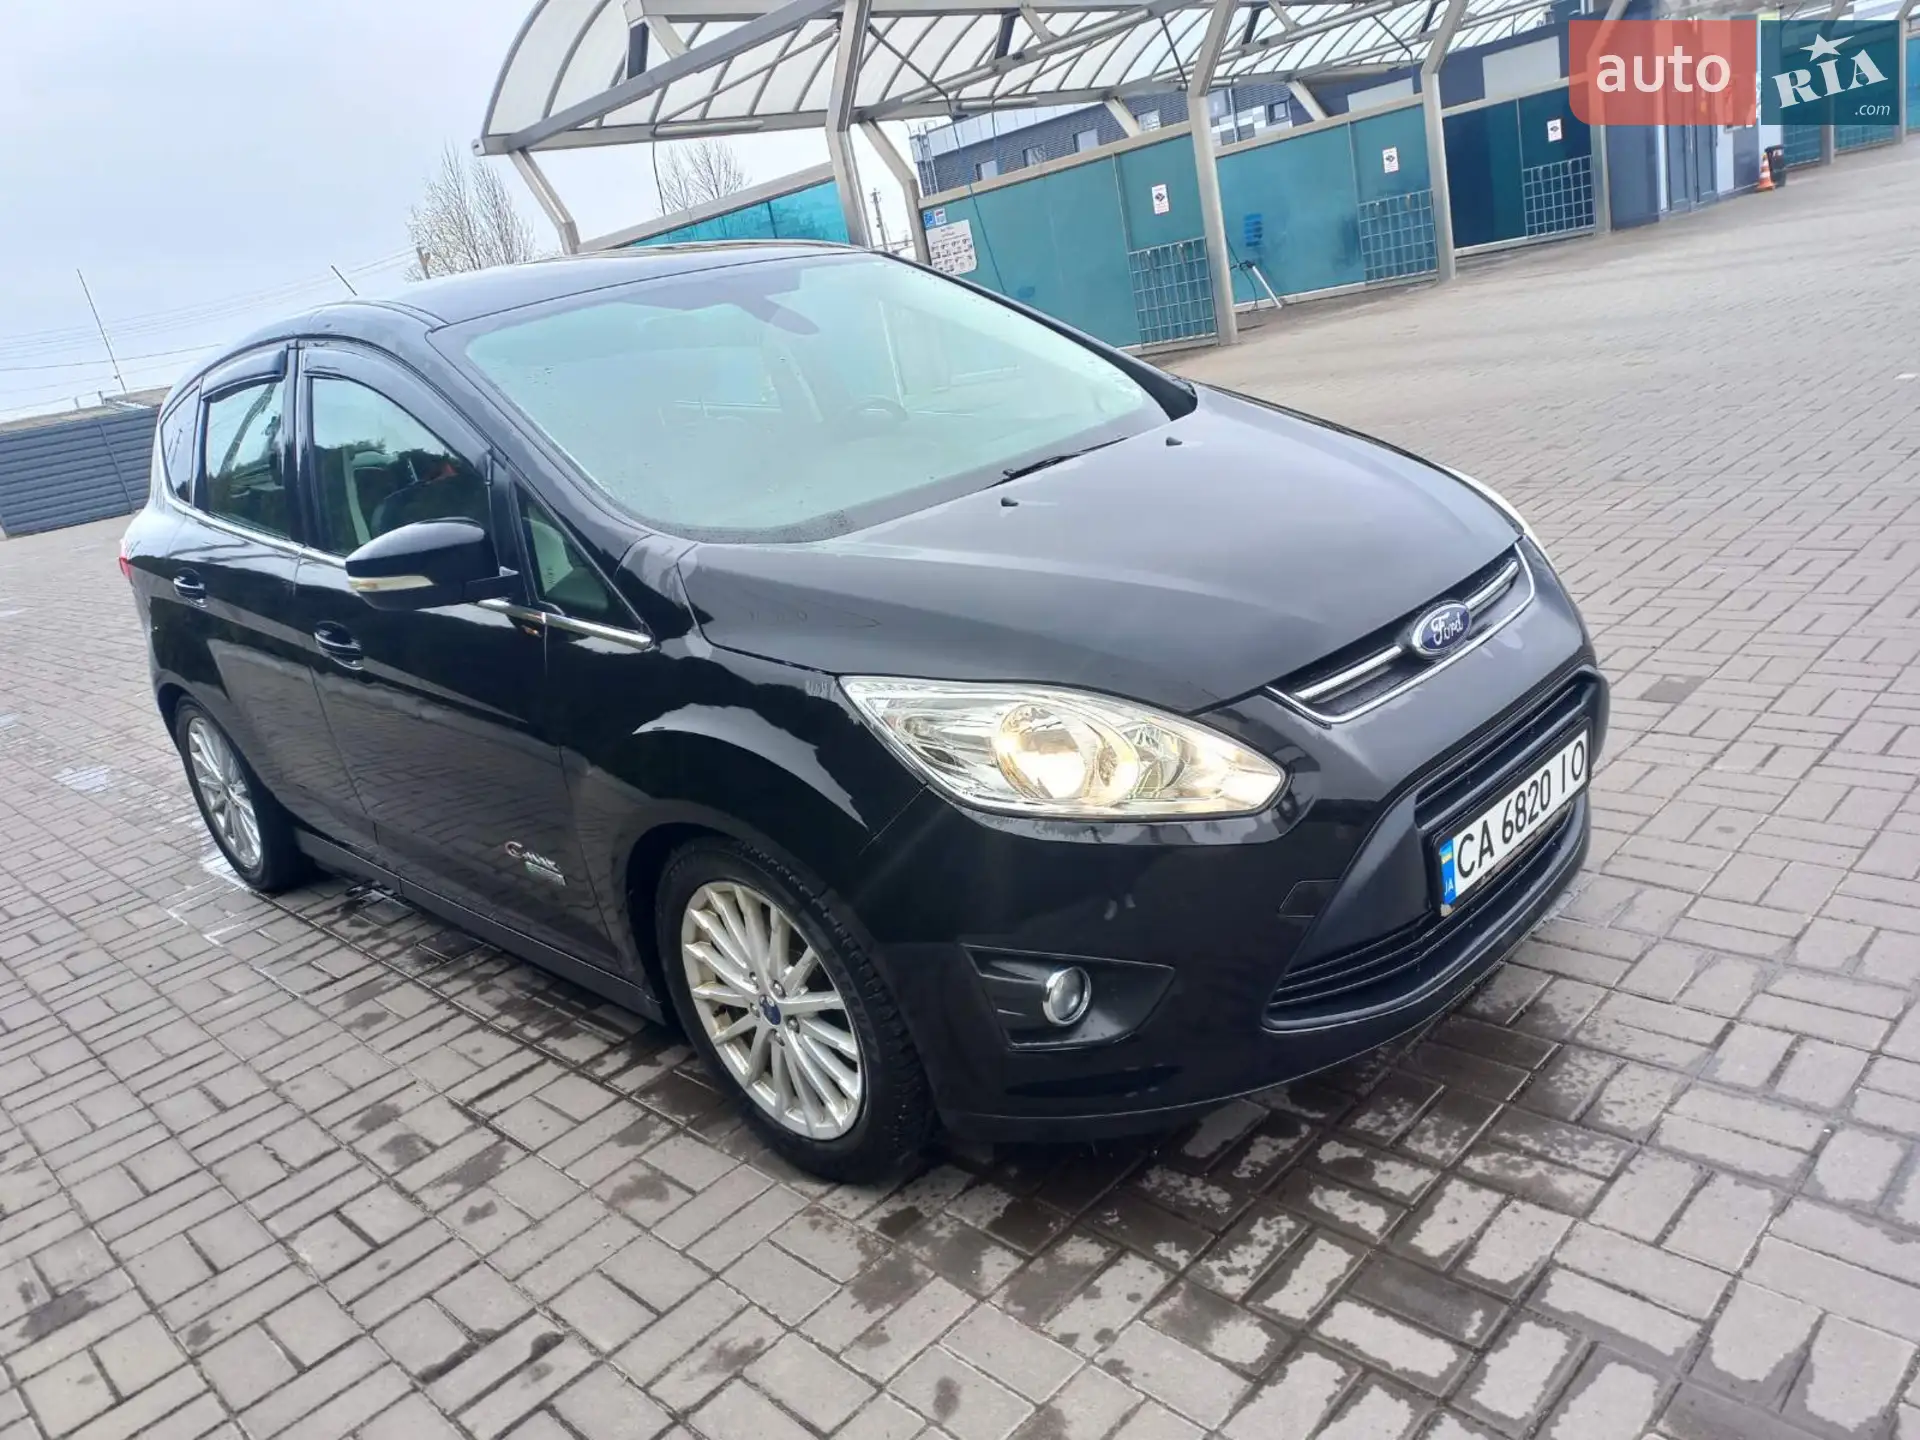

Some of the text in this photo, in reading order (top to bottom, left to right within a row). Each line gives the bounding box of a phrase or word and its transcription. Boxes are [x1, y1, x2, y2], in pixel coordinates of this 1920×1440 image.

[1431, 612, 1464, 646] Ford
[1457, 820, 1495, 879] CA
[1502, 769, 1552, 845] 6820
